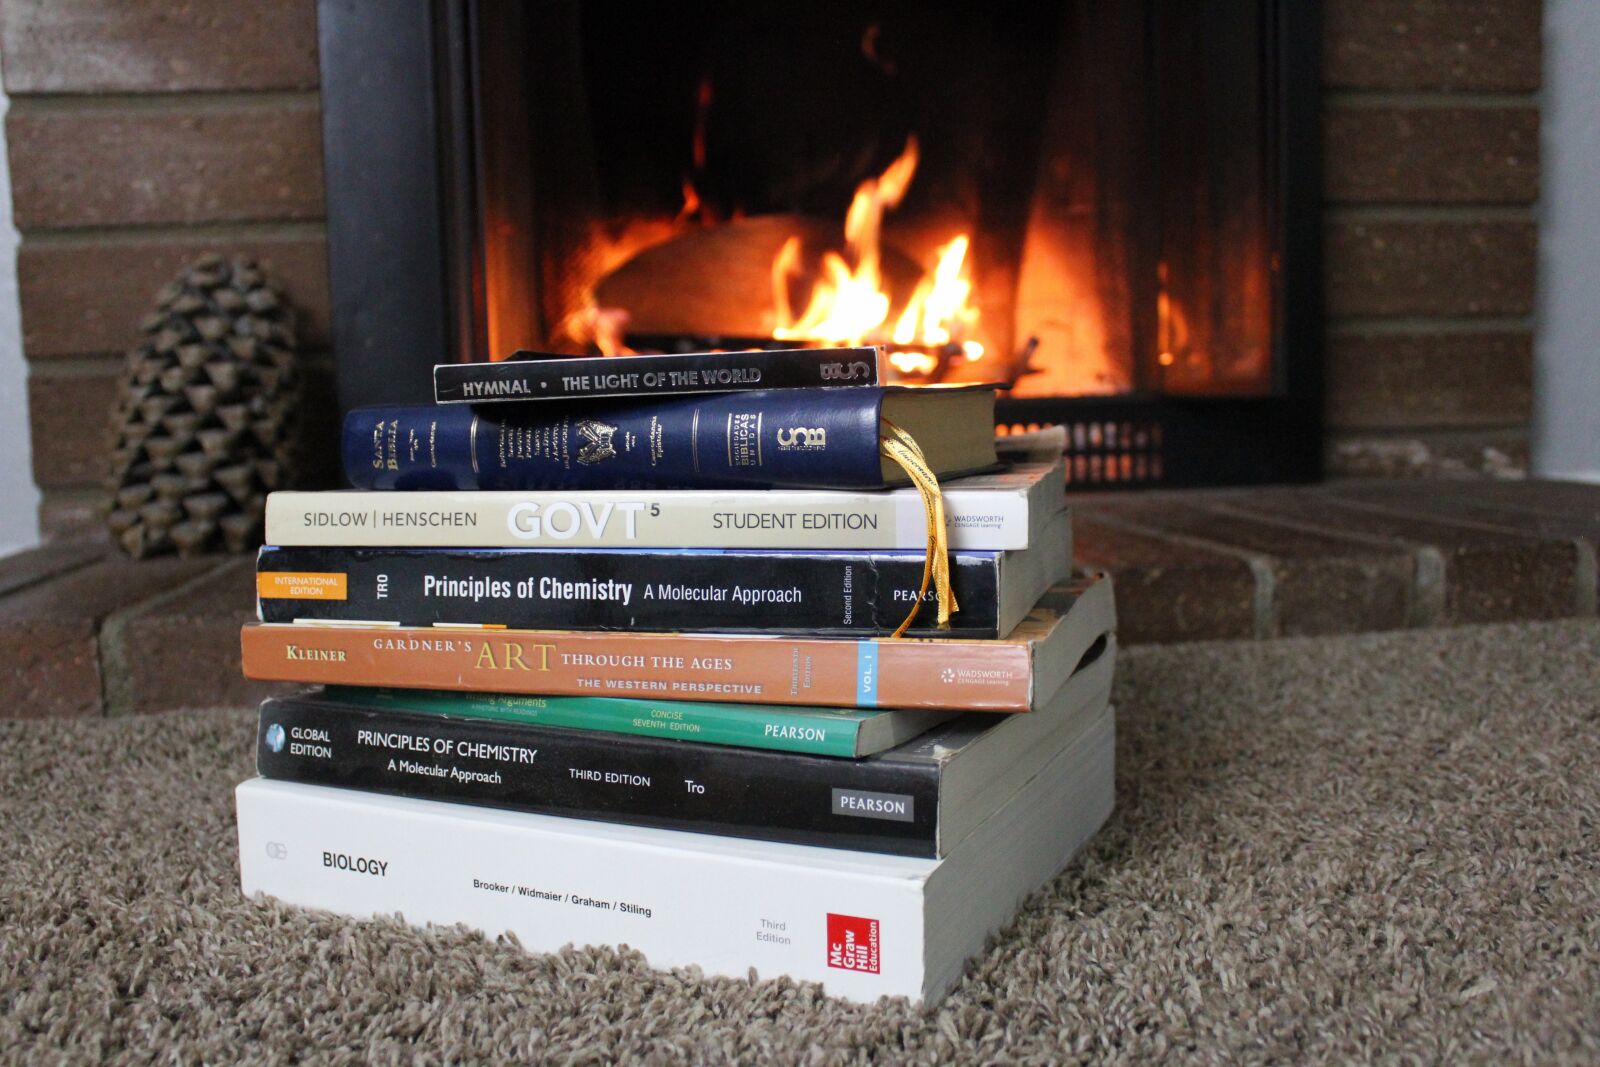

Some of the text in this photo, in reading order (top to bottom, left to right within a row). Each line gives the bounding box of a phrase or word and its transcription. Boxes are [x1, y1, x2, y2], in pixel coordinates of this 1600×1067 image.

[462, 367, 762, 396] HYMNAL THE LIGHT OF THE WORLD
[373, 420, 384, 470] SANTA
[387, 419, 399, 471] BIBLIA
[304, 512, 368, 527] SIDLOW
[382, 512, 477, 527] HENSCHEN
[506, 502, 645, 540] GOVT
[650, 503, 660, 517] 5
[713, 514, 796, 530] STUDENT
[802, 513, 878, 530] EDITION
[954, 515, 1004, 523] WADSWORTH
[274, 577, 338, 587] INTERNATIONAL
[290, 586, 323, 596] EDITION
[377, 574, 388, 599] TRO
[424, 575, 802, 606] Principles of Chemistry A Molecular Approach
[844, 566, 852, 625] Second Edition
[894, 590, 940, 601] PEARS
[373, 638, 472, 652] GARDNER'S
[475, 642, 557, 671] ART
[561, 653, 644, 668] THROUGH
[650, 656, 685, 669] THE
[691, 657, 733, 670] AGES
[863, 664, 872, 692] VOL.
[958, 670, 1013, 678] WADSWORTH
[576, 678, 762, 694] THE WESTERN PERSPECTIVE
[632, 719, 701, 732] SEVENTH EDITION
[651, 710, 684, 720] CONCISE
[291, 727, 331, 743] GLOBAL
[764, 724, 826, 742] PEARSON
[290, 742, 331, 759] EDITION
[357, 730, 538, 765] PRINCIPLES OF CHEMISTRY
[387, 760, 502, 784] A Molecular Approach
[568, 768, 651, 787] THIRD EDITION
[685, 779, 705, 795] Tro
[840, 797, 905, 815] PEARSON
[323, 851, 388, 877] BIOLOGY
[473, 879, 509, 893] Brooker
[518, 885, 562, 902] Widmaier
[571, 894, 610, 910] Graham
[620, 902, 652, 918] Stiling
[760, 919, 786, 931] Third
[756, 931, 791, 945] Edition
[843, 930, 855, 968] Graw
[869, 922, 877, 971] Education
[830, 943, 842, 966] Mc
[856, 945, 868, 970] Hill
